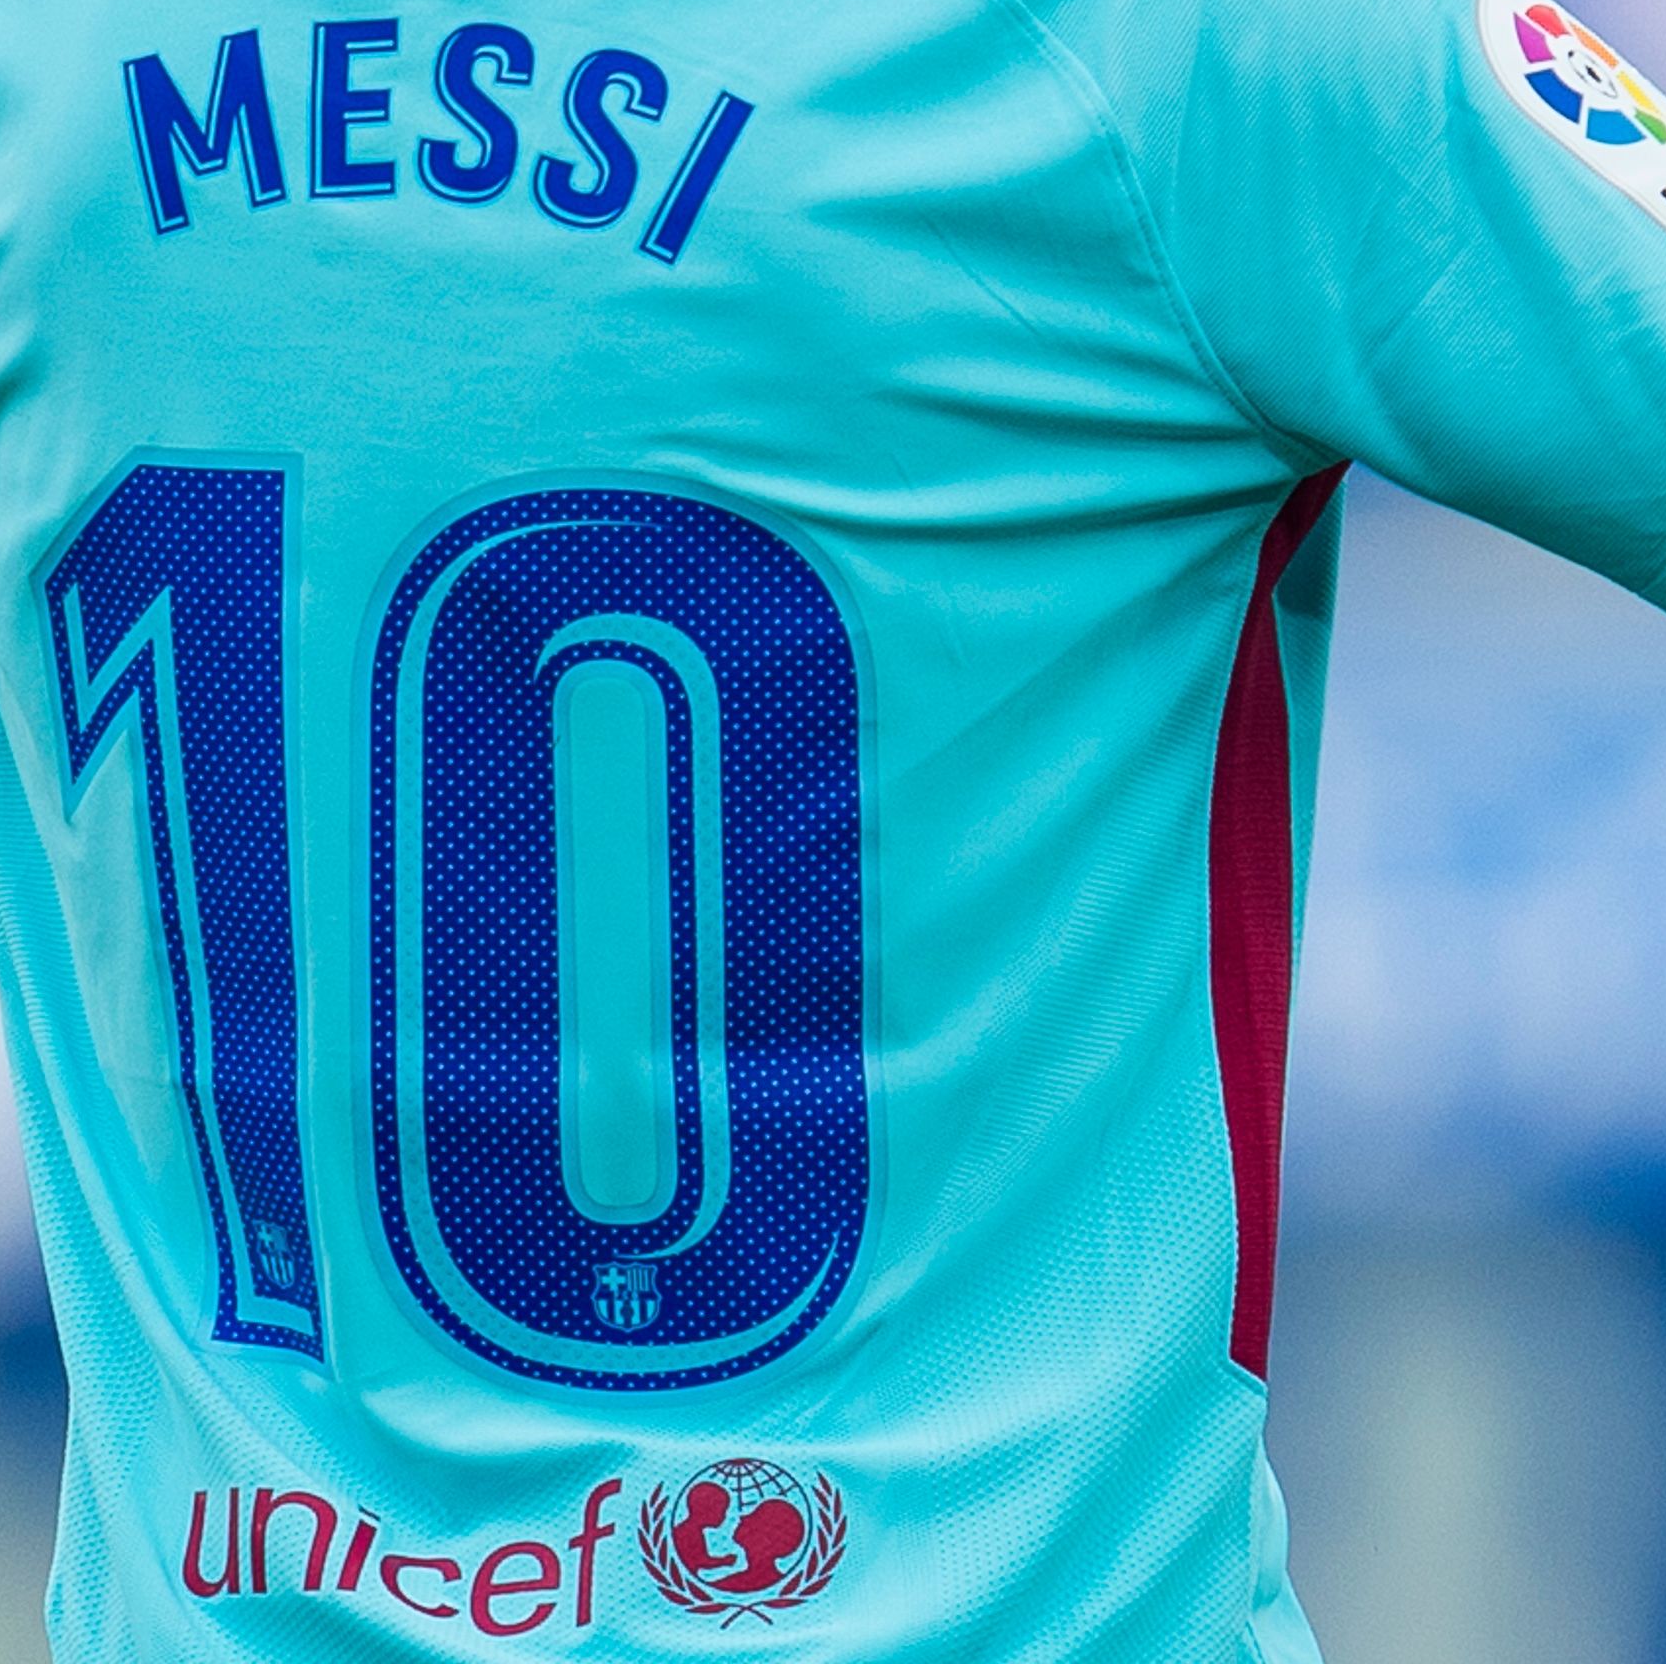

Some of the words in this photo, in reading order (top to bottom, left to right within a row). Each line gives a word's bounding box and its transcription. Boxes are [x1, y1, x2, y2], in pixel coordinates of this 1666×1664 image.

[123, 18, 754, 264] MESSI
[42, 462, 871, 1392] 10
[182, 1478, 622, 1637] unicef
